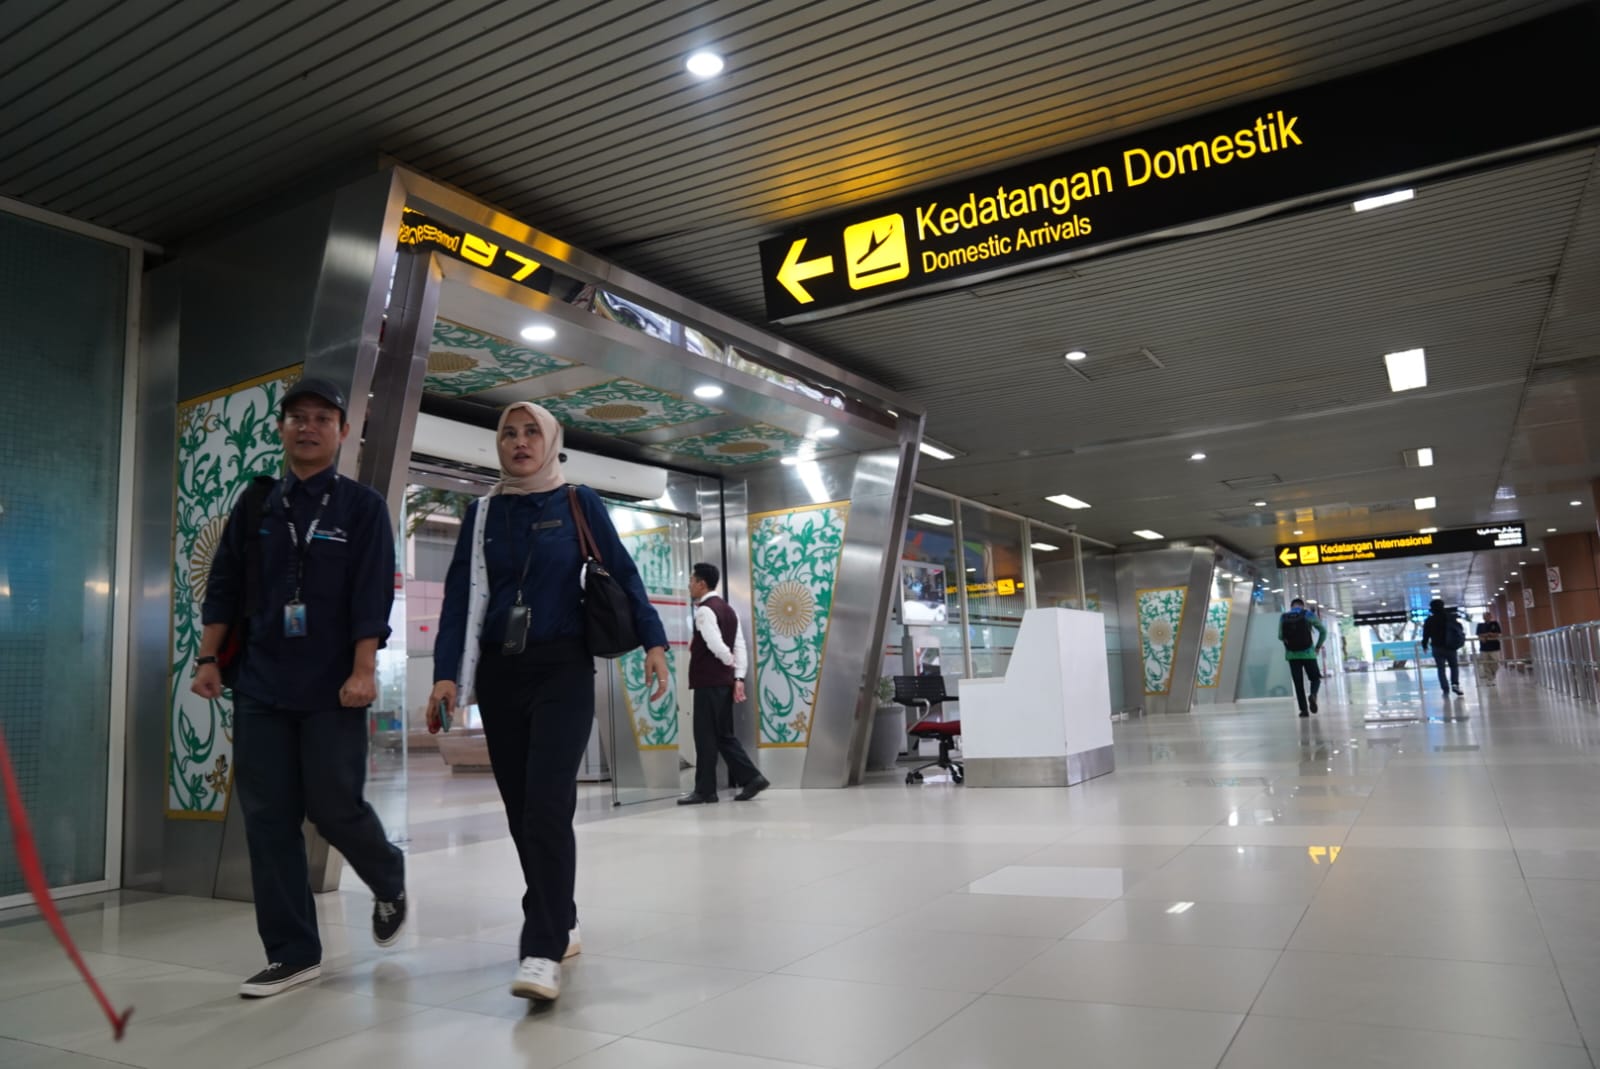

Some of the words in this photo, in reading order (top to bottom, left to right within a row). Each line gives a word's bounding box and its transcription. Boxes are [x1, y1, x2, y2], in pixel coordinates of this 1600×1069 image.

[916, 167, 1113, 241] Kedatangan
[1123, 110, 1303, 188] Domestik
[921, 236, 1012, 274] Domestic
[1015, 214, 1093, 251] Arrivals
[1320, 541, 1373, 554] Kedatangan
[1374, 534, 1433, 550] Internasional
